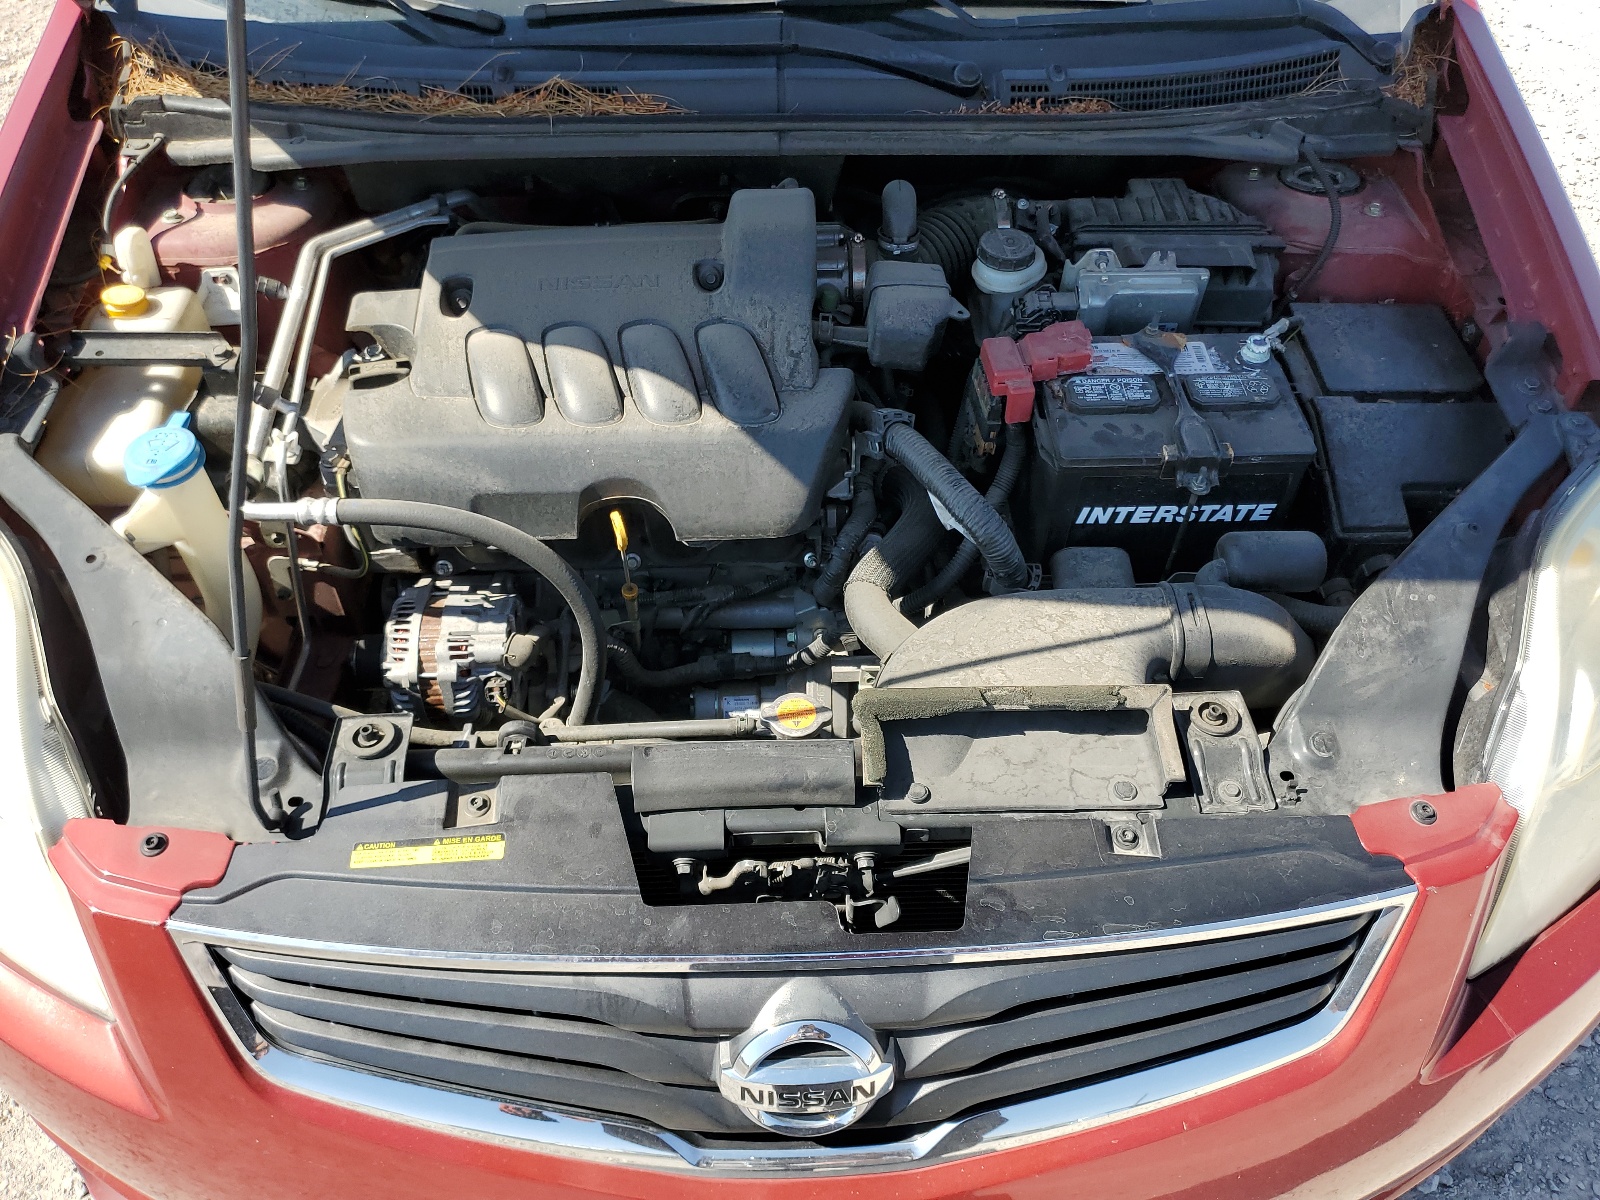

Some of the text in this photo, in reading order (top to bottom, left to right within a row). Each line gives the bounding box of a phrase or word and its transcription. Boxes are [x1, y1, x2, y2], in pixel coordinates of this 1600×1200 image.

[537, 274, 660, 291] NISSAN
[1075, 503, 1278, 525] INTERSTATE
[363, 842, 397, 850] CAUTION
[442, 837, 461, 845] MISE
[474, 834, 502, 843] GARDE
[740, 1080, 876, 1108] NISSAN
